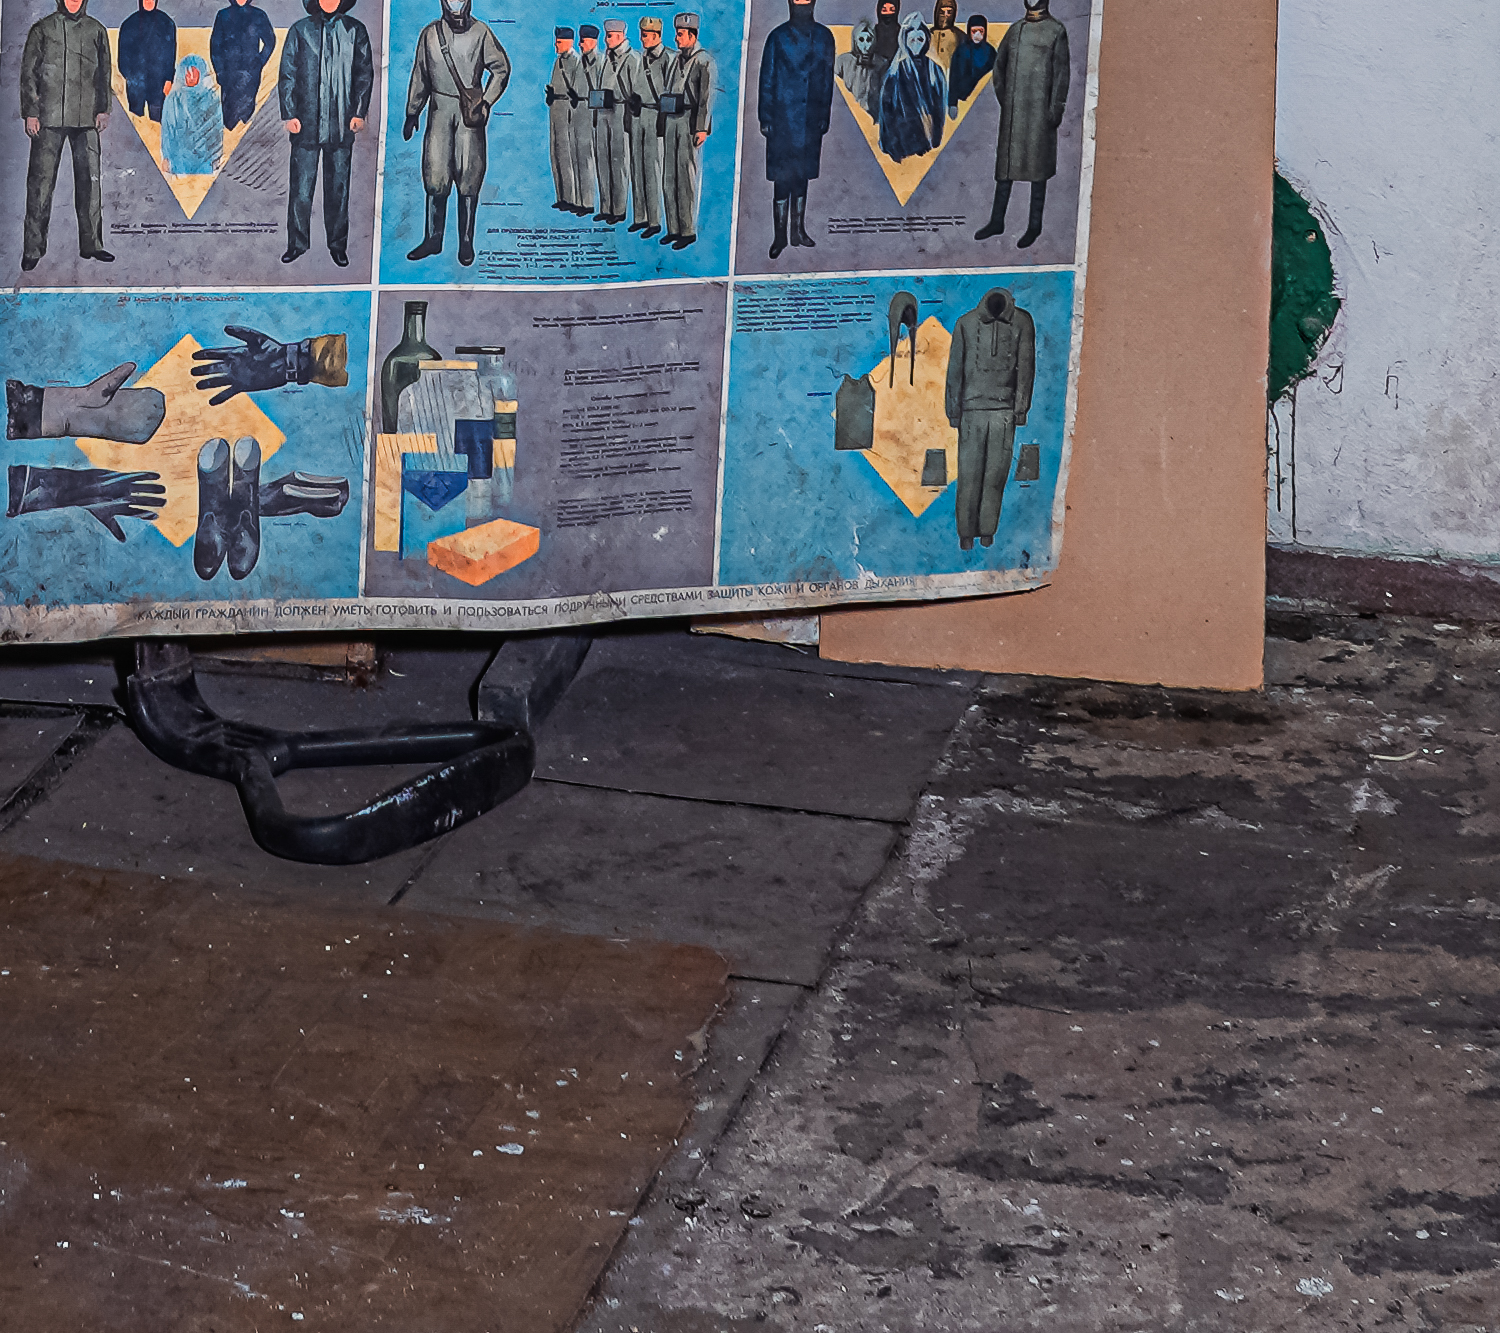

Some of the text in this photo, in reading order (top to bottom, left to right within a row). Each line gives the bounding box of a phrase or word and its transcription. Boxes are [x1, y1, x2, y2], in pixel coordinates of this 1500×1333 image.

[138, 606, 190, 621] КАЖДЫЙ
[275, 604, 326, 617] ДОЛЖЕН
[333, 604, 370, 616] УМЕТЬ
[376, 605, 437, 616] ГОТОВИТЬ
[444, 605, 451, 615] И
[458, 604, 548, 618] ПОЛЬЗОВАТЬСЯ
[631, 590, 702, 605] СРЕДСТВАМИ
[707, 586, 753, 600] ЗАЩИТЫ
[758, 582, 792, 596] КОЖИ
[797, 581, 805, 593] И
